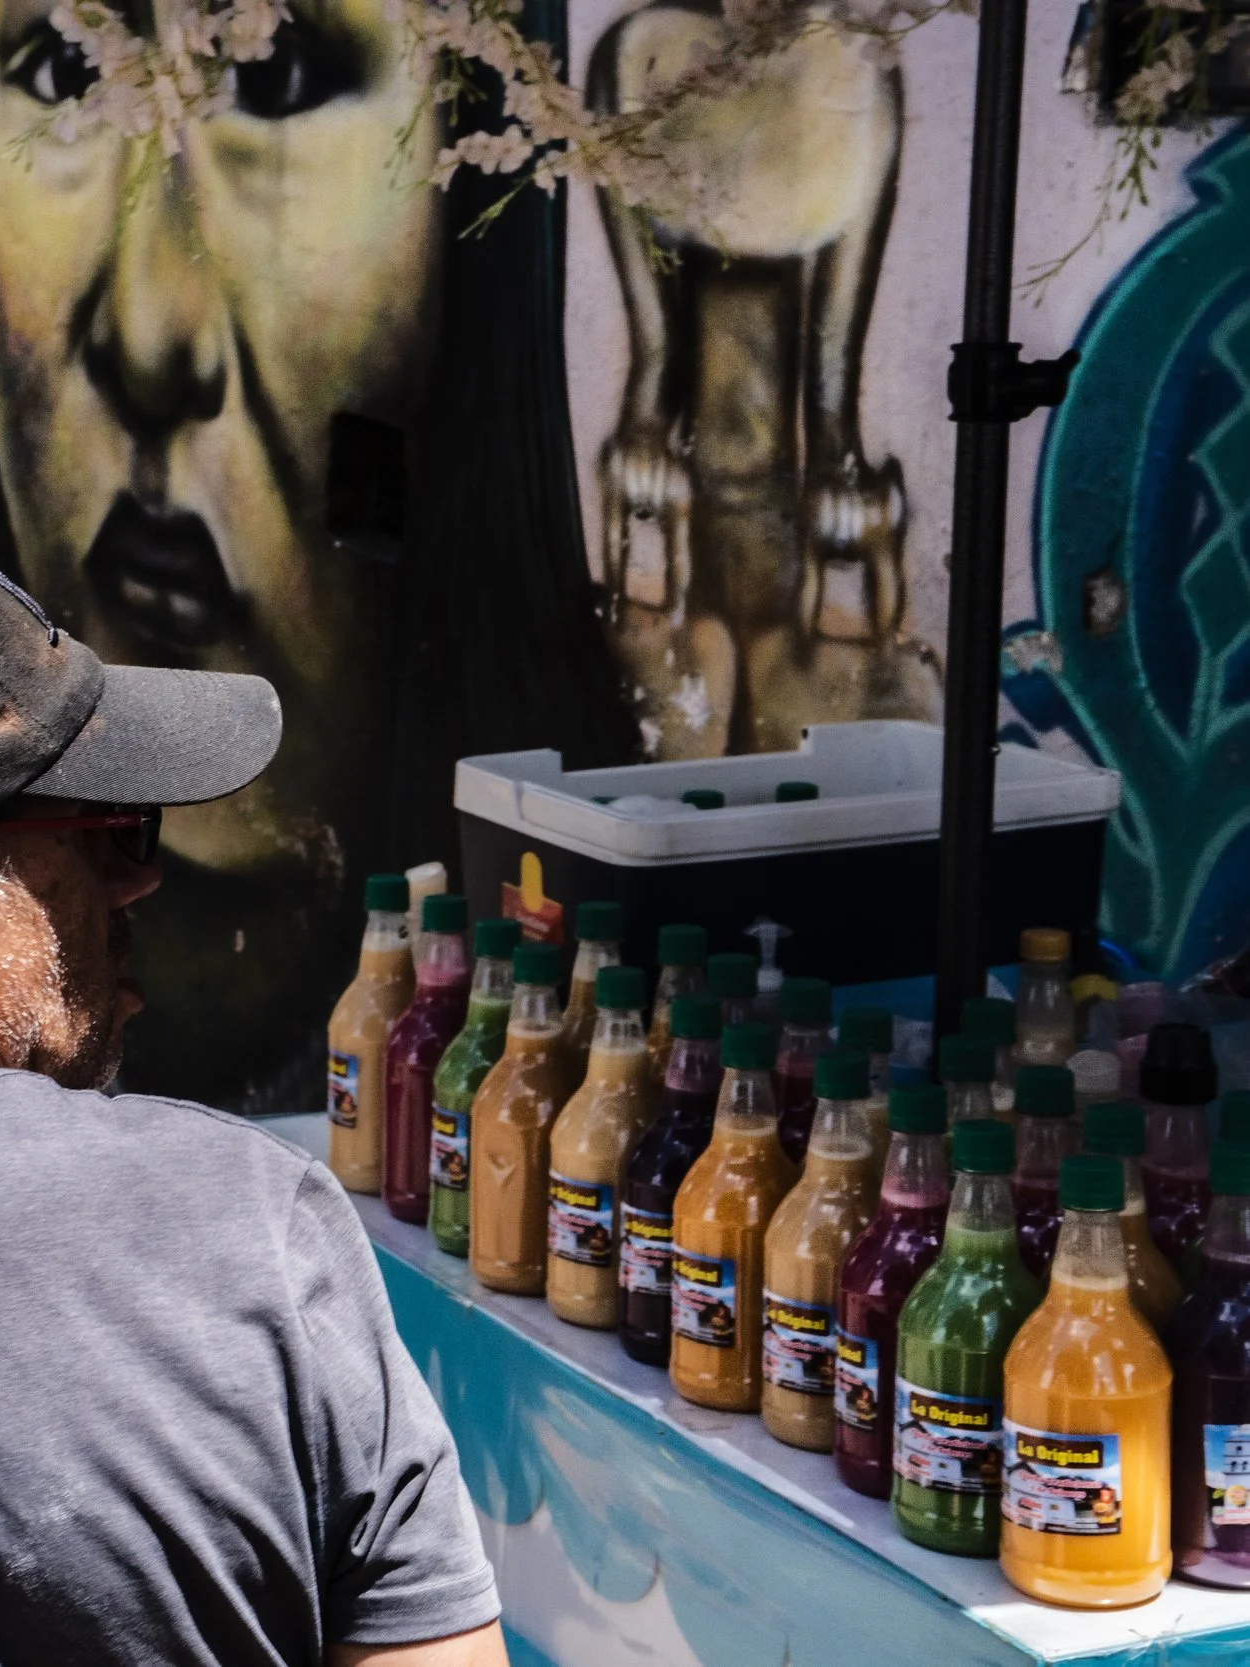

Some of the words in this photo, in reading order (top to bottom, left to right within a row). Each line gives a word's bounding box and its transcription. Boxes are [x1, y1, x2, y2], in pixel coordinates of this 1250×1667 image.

[776, 1310, 826, 1330] Original
[911, 1399, 927, 1417] La
[928, 1405, 989, 1427] Original
[1017, 1439, 1035, 1458] La
[1036, 1445, 1100, 1467] Original
